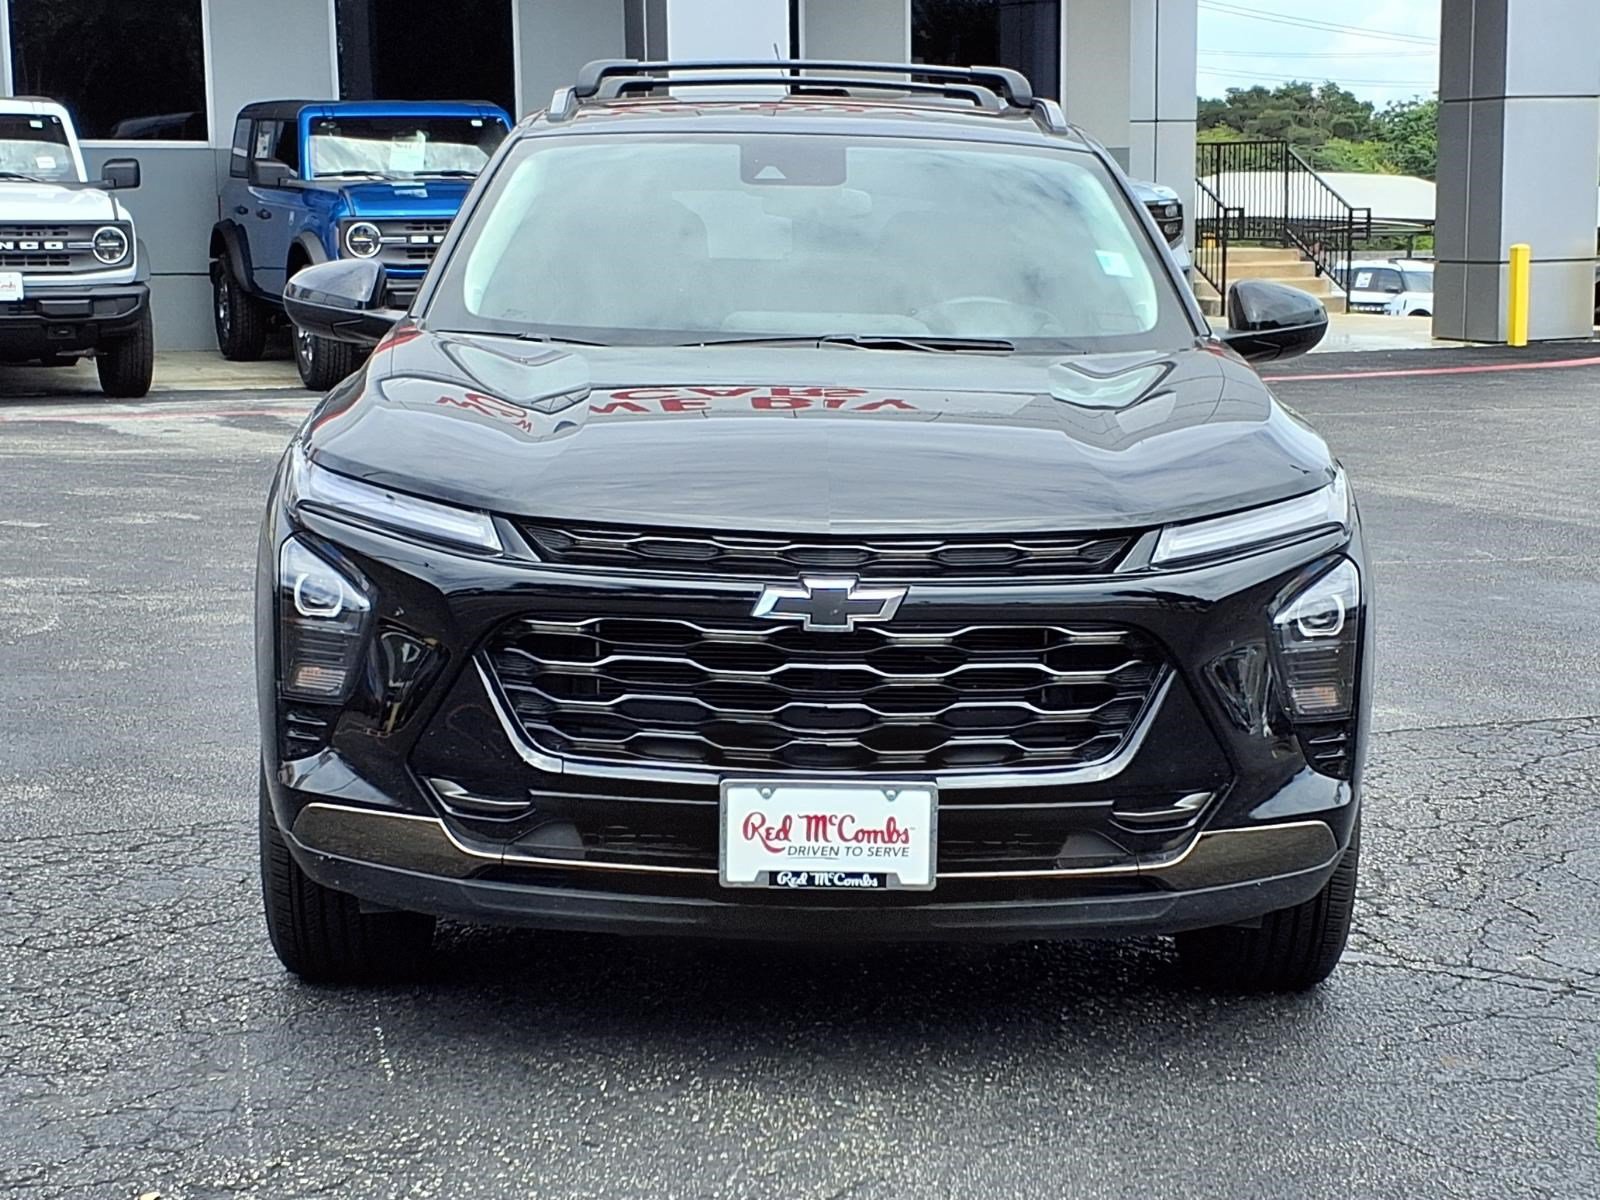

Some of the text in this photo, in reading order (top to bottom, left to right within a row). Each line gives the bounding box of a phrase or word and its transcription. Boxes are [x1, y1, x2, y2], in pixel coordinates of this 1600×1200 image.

[742, 811, 910, 854] Red McCombs
[787, 845, 910, 857] DRIVEN TO SERVE
[776, 871, 878, 888] Red McCombs
